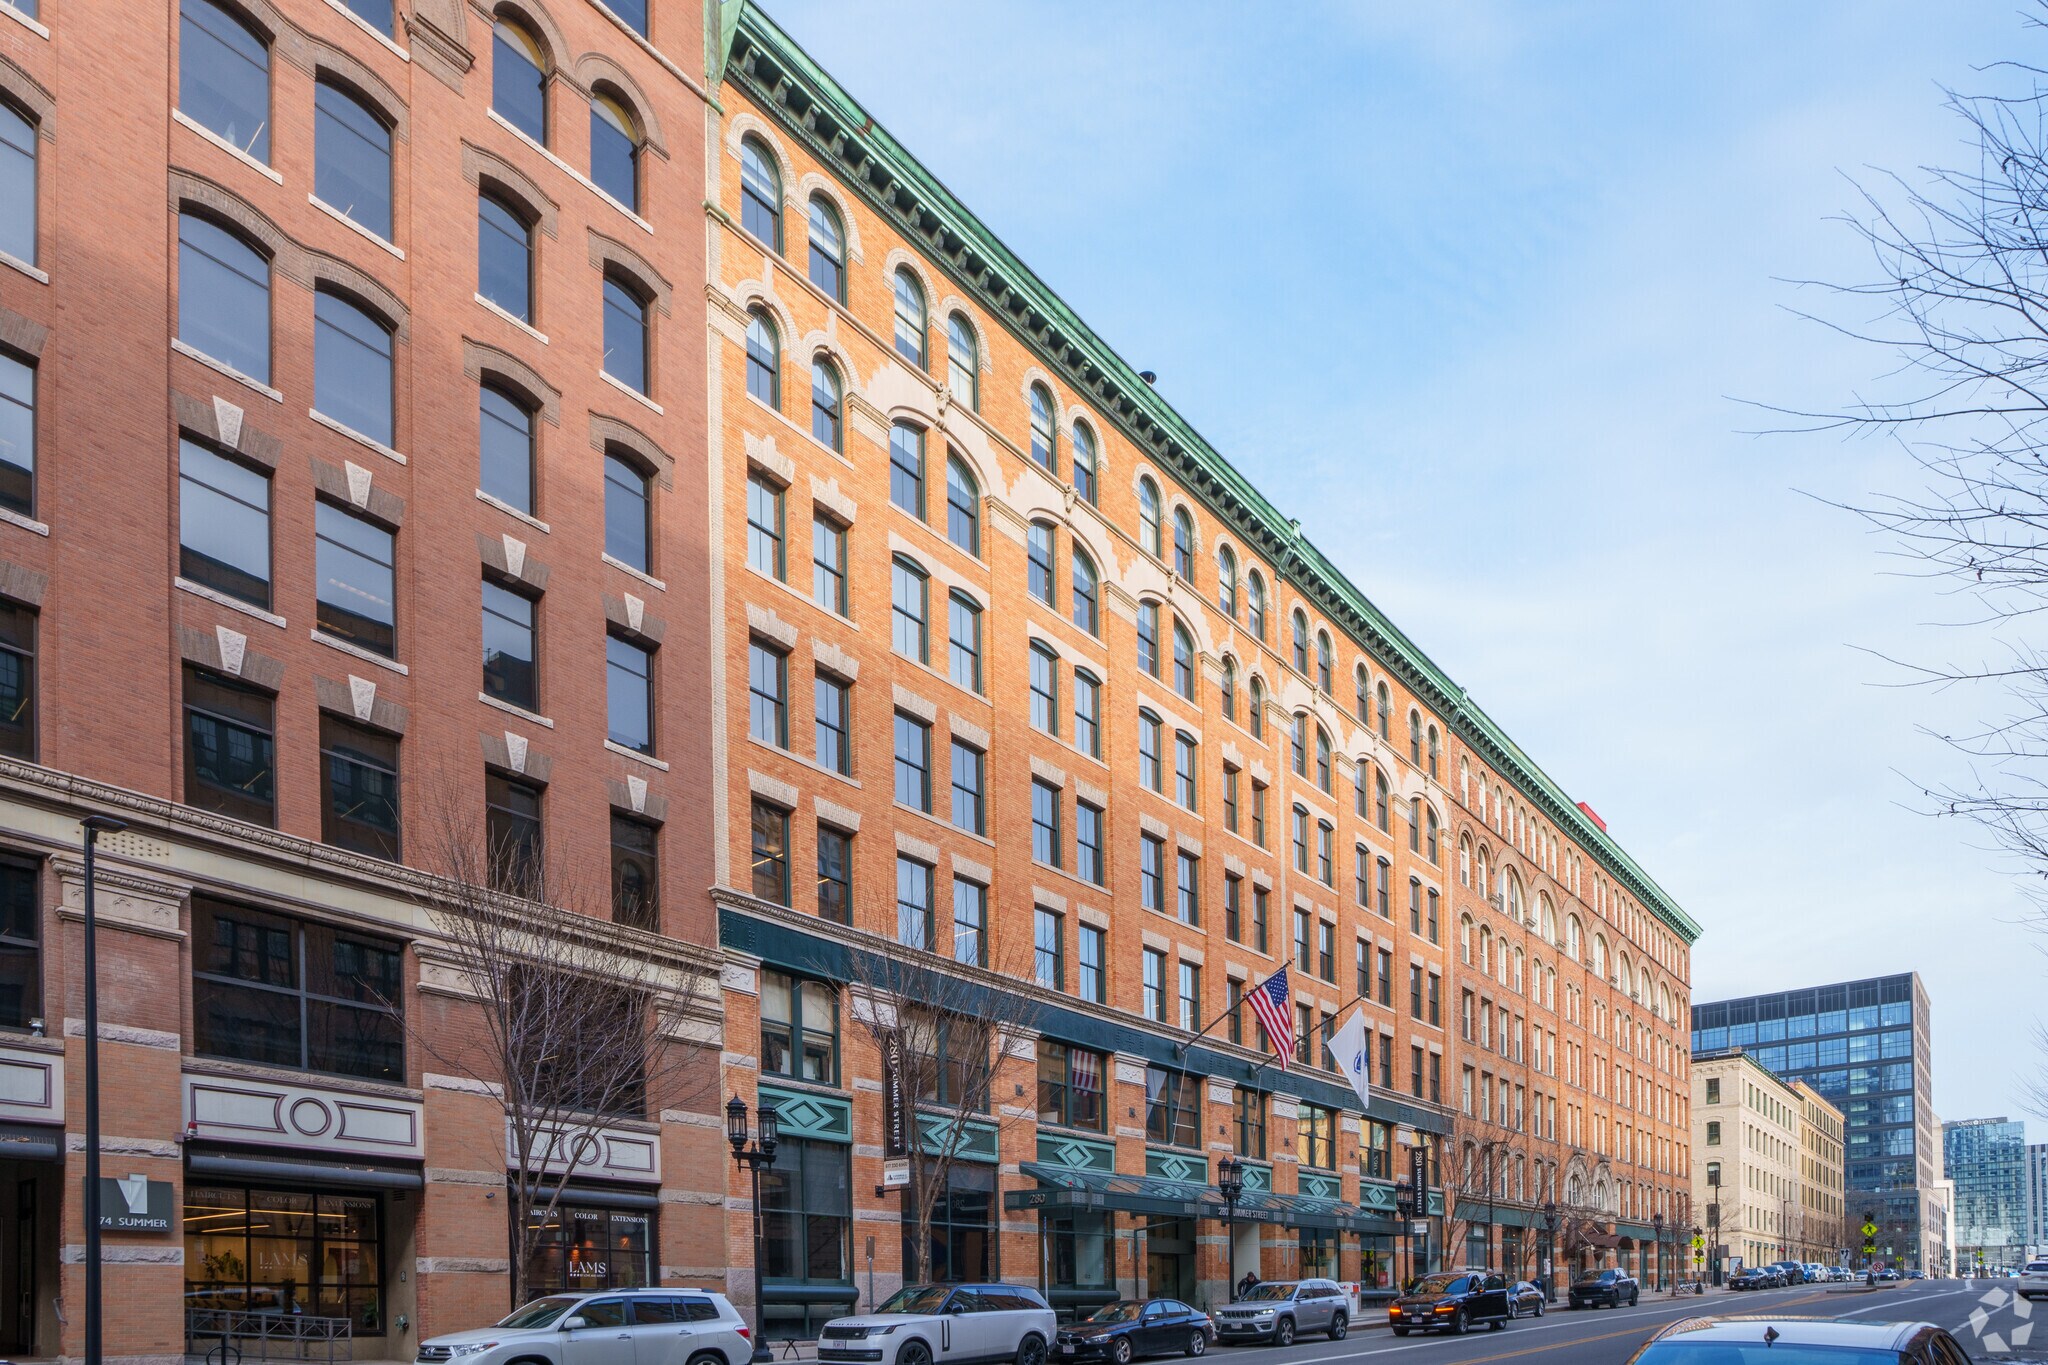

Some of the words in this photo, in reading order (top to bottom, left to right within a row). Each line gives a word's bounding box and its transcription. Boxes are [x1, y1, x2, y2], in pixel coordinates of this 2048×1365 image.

[889, 1038, 898, 1065] 280
[893, 1111, 901, 1149] STREET
[1415, 1151, 1423, 1167] 280
[266, 1196, 297, 1204] COLOR
[323, 1199, 371, 1209] EXTENSIONS
[1029, 1194, 1046, 1204] 280
[574, 1212, 598, 1220] COLOR
[611, 1215, 648, 1223] EXTENSIONS
[1218, 1207, 1229, 1216] 280
[1233, 1208, 1252, 1218] UMMER
[1252, 1210, 1268, 1219] STREET
[118, 1217, 167, 1228] SUMMER
[259, 1251, 308, 1266] LAMS
[569, 1260, 607, 1274] LAMS
